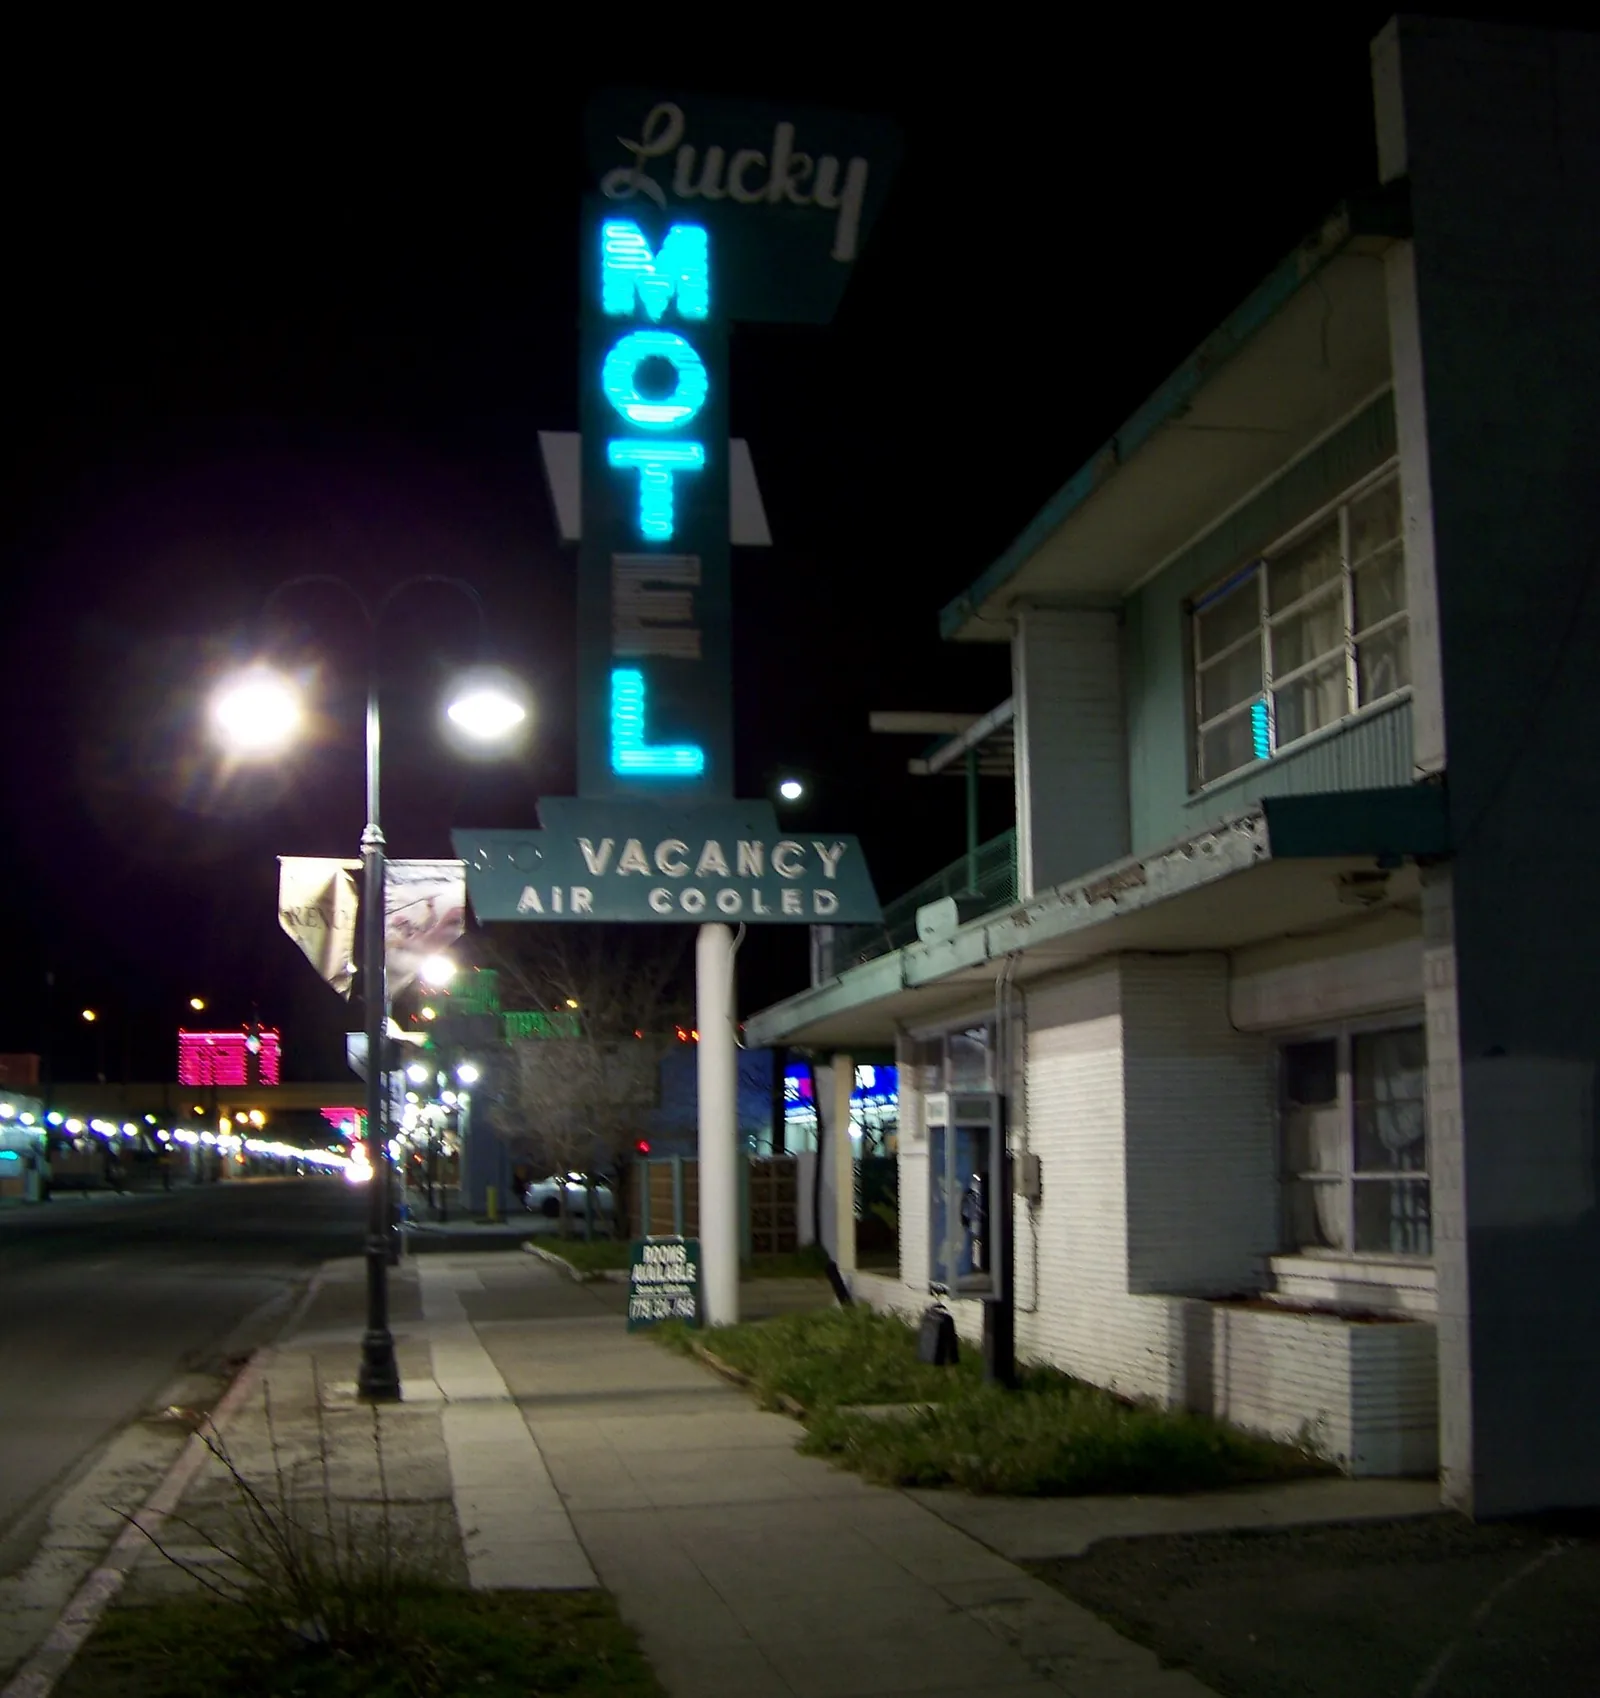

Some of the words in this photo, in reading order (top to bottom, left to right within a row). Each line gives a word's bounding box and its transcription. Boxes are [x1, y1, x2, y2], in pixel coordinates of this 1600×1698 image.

[601, 101, 869, 263] Lucky
[601, 219, 709, 776] MOTEL
[577, 837, 848, 880] VACANCY
[516, 885, 594, 915] AIR
[648, 887, 840, 916] COOLED
[642, 1244, 688, 1264] ROOMS
[631, 1263, 697, 1283] AVAILABLE
